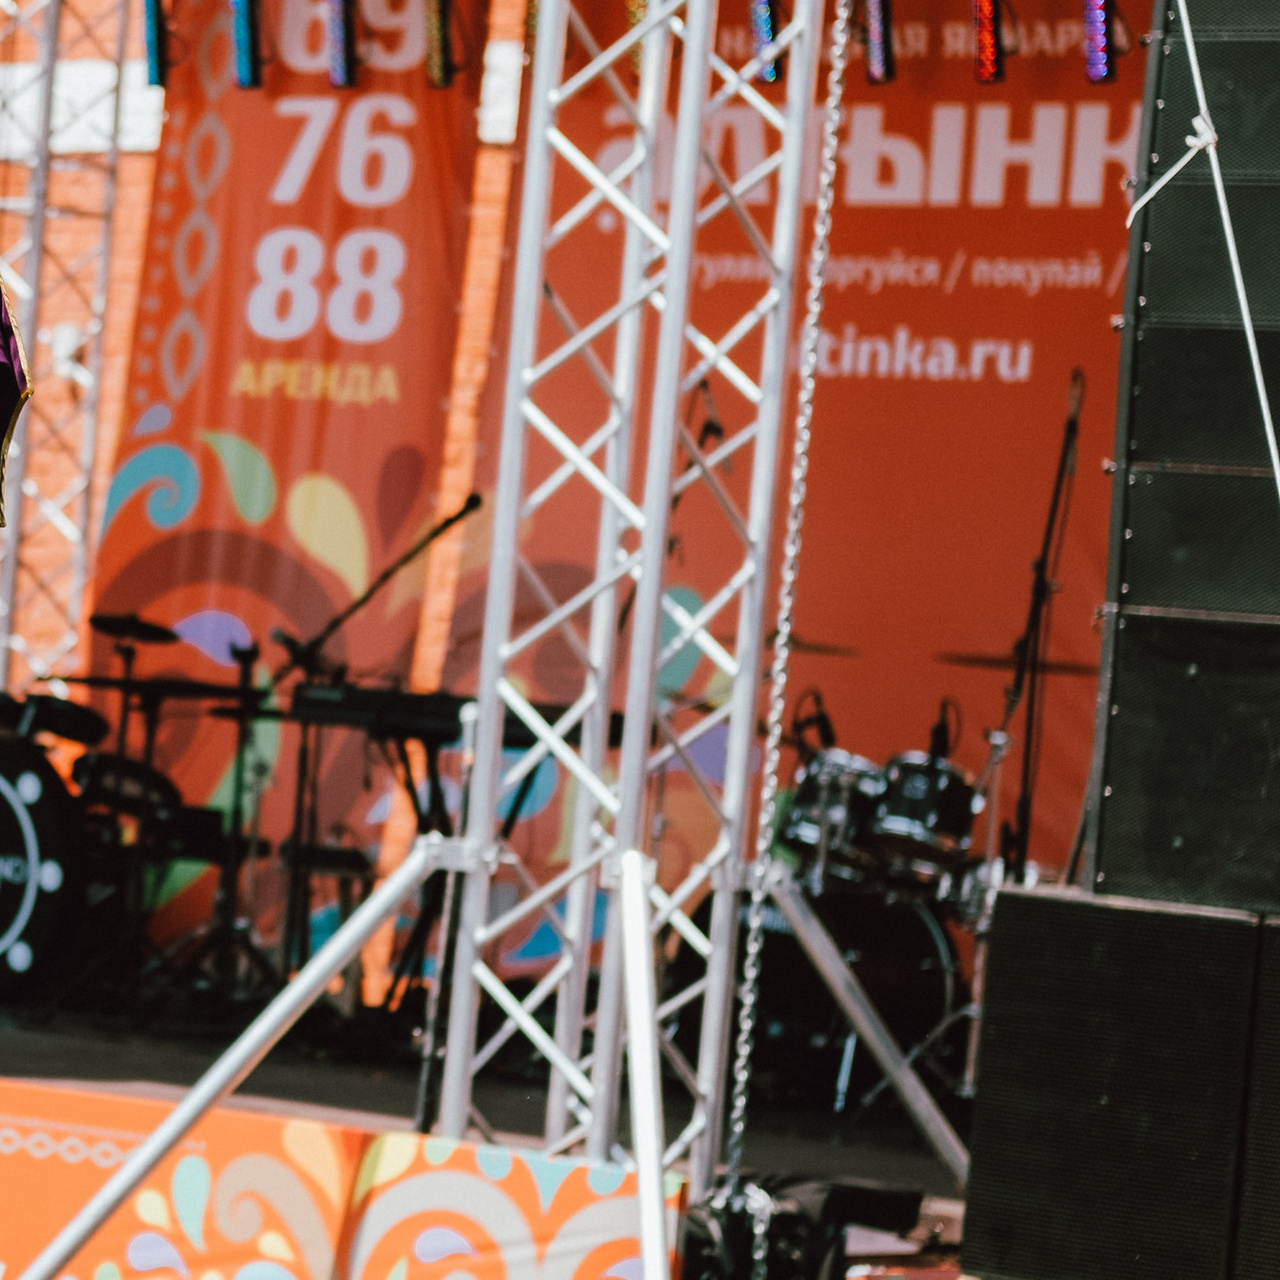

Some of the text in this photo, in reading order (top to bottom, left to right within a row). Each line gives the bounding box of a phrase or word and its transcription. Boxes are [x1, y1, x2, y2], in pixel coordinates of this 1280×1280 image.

[269, 93, 417, 208] 76
[246, 227, 407, 344] 88
[806, 247, 940, 294] оргуйся
[788, 323, 1032, 382] tinka.ru
[231, 360, 400, 407] АРЕНДА
